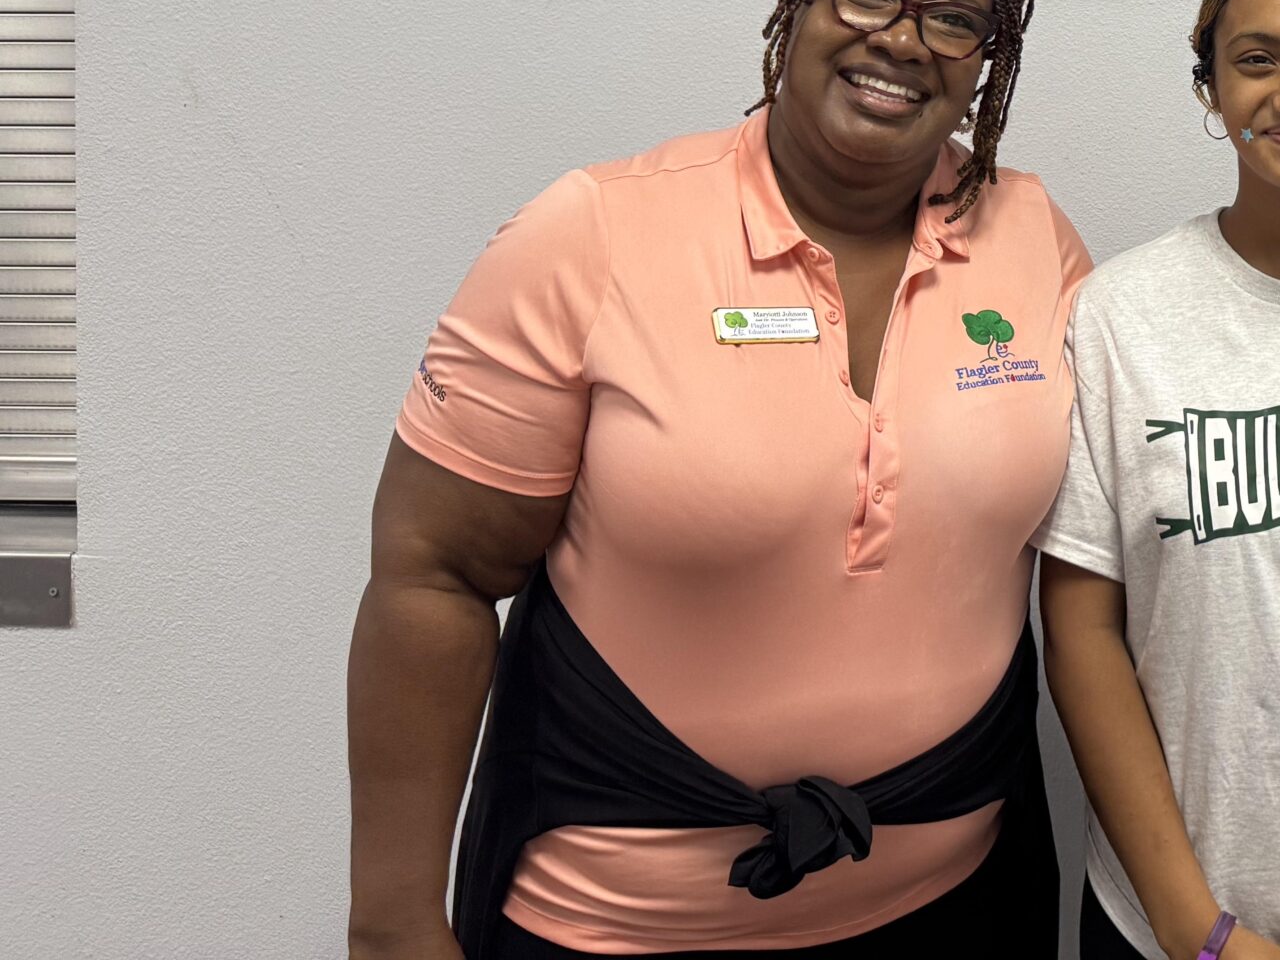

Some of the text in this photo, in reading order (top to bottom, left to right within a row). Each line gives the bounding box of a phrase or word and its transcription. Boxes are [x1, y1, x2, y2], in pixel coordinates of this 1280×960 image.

[955, 359, 1039, 379] Flagler County
[956, 372, 1046, 391] Education Foundation
